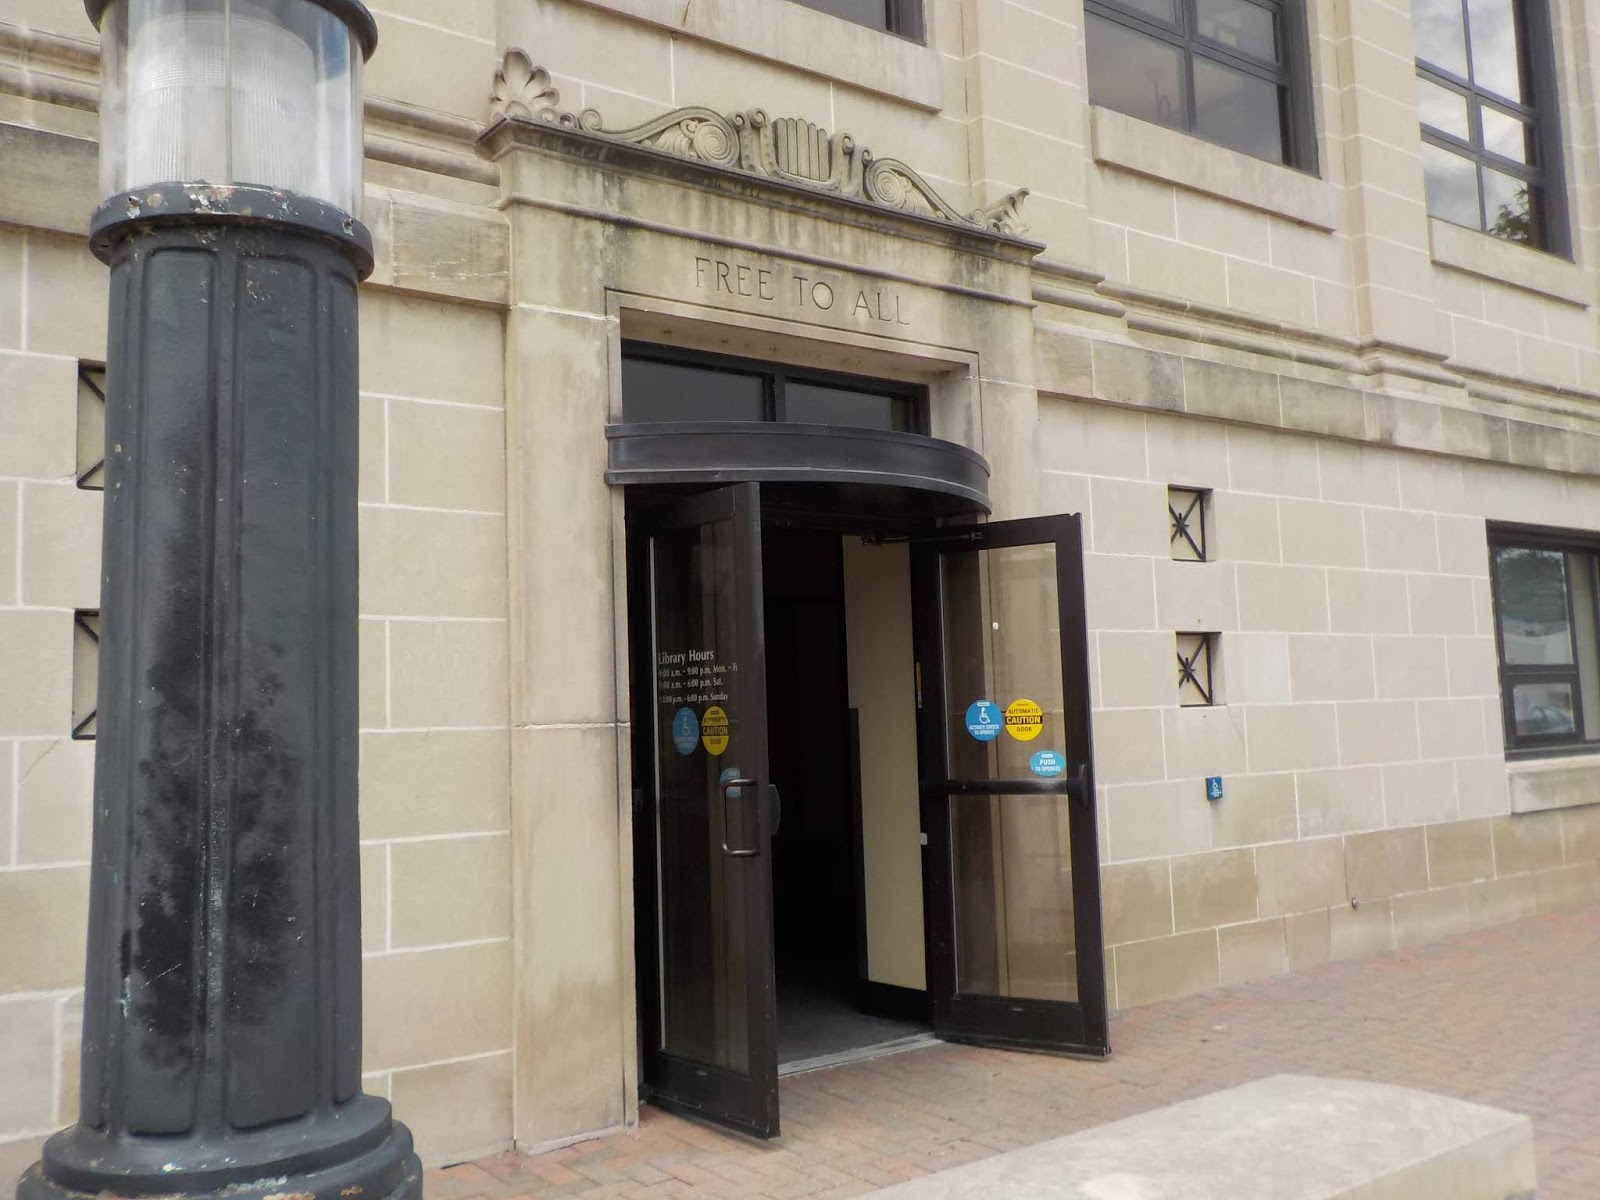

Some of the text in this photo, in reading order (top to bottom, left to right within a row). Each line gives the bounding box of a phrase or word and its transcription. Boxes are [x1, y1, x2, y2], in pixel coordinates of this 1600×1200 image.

[694, 256, 911, 326] FREE TO ALL
[658, 650, 715, 666] Library Hours
[687, 666, 698, 676] 9:00
[700, 667, 712, 676] p.m.
[700, 679, 712, 689] p.m.
[711, 692, 729, 702] Sunday
[1006, 716, 1041, 724] CAUTION
[703, 726, 728, 735] CAUTION
